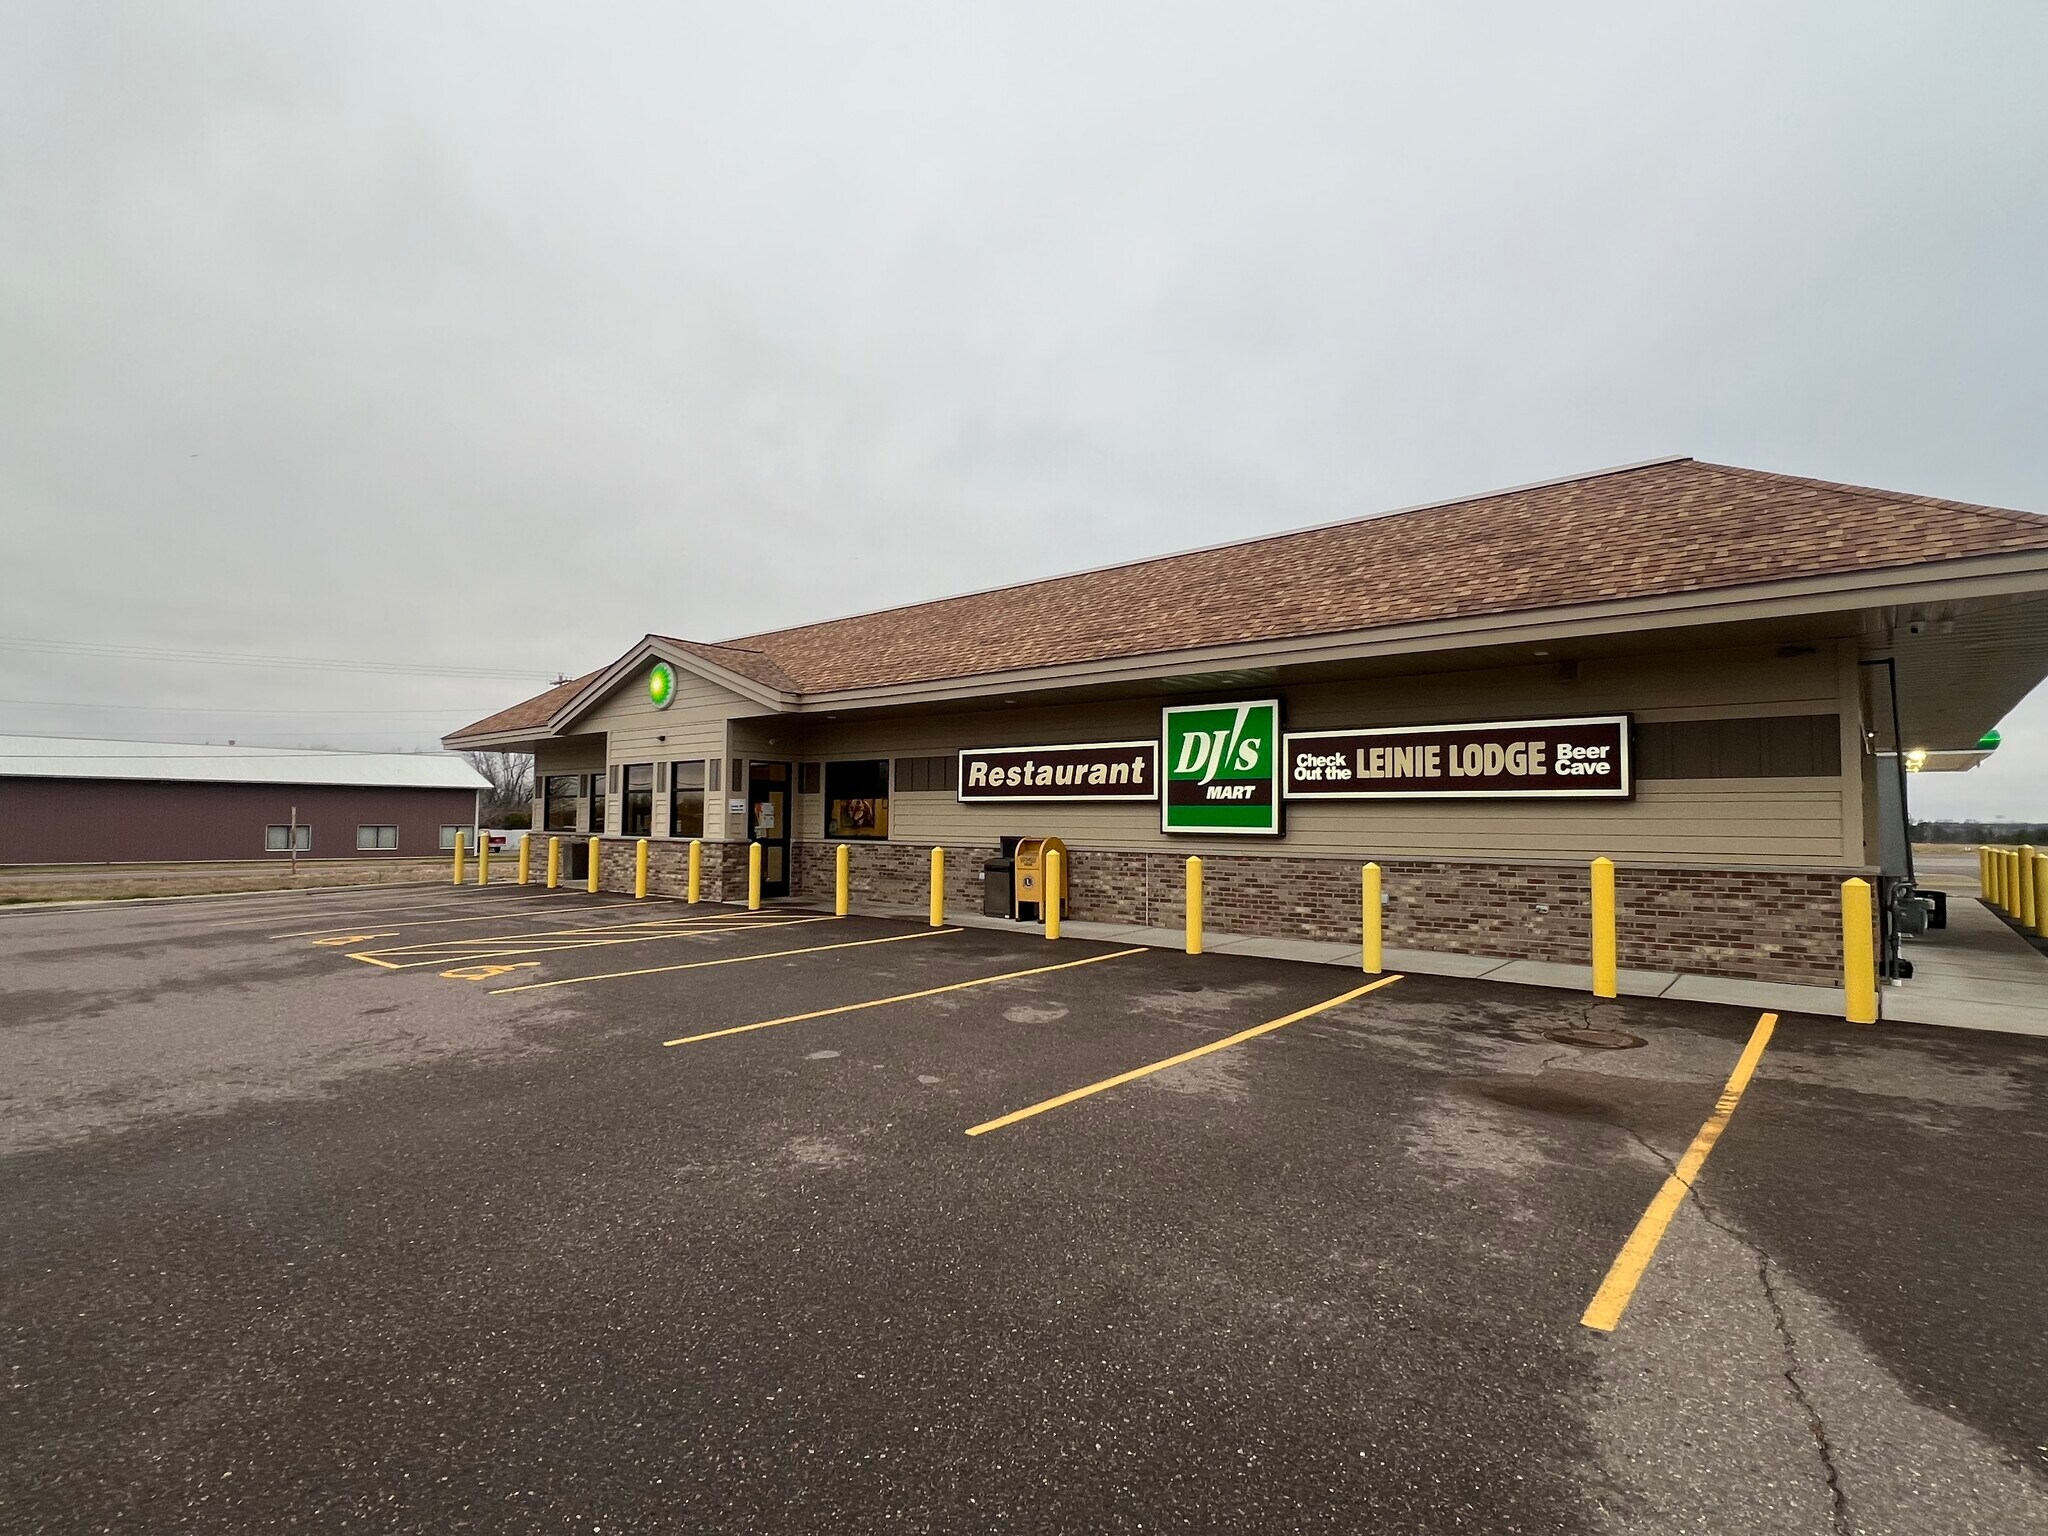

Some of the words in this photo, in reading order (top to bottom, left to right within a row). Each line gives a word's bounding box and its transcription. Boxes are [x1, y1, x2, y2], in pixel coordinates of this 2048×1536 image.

[1557, 743, 1610, 759] Beer
[1296, 753, 1346, 767] Check
[1356, 745, 1441, 778] LEINIE
[1449, 741, 1547, 777] LODGE
[968, 757, 1145, 787] Restaurant
[1294, 767, 1322, 780] Out
[1326, 767, 1352, 780] the
[1555, 760, 1610, 776] Cave
[1206, 785, 1256, 800] MART
